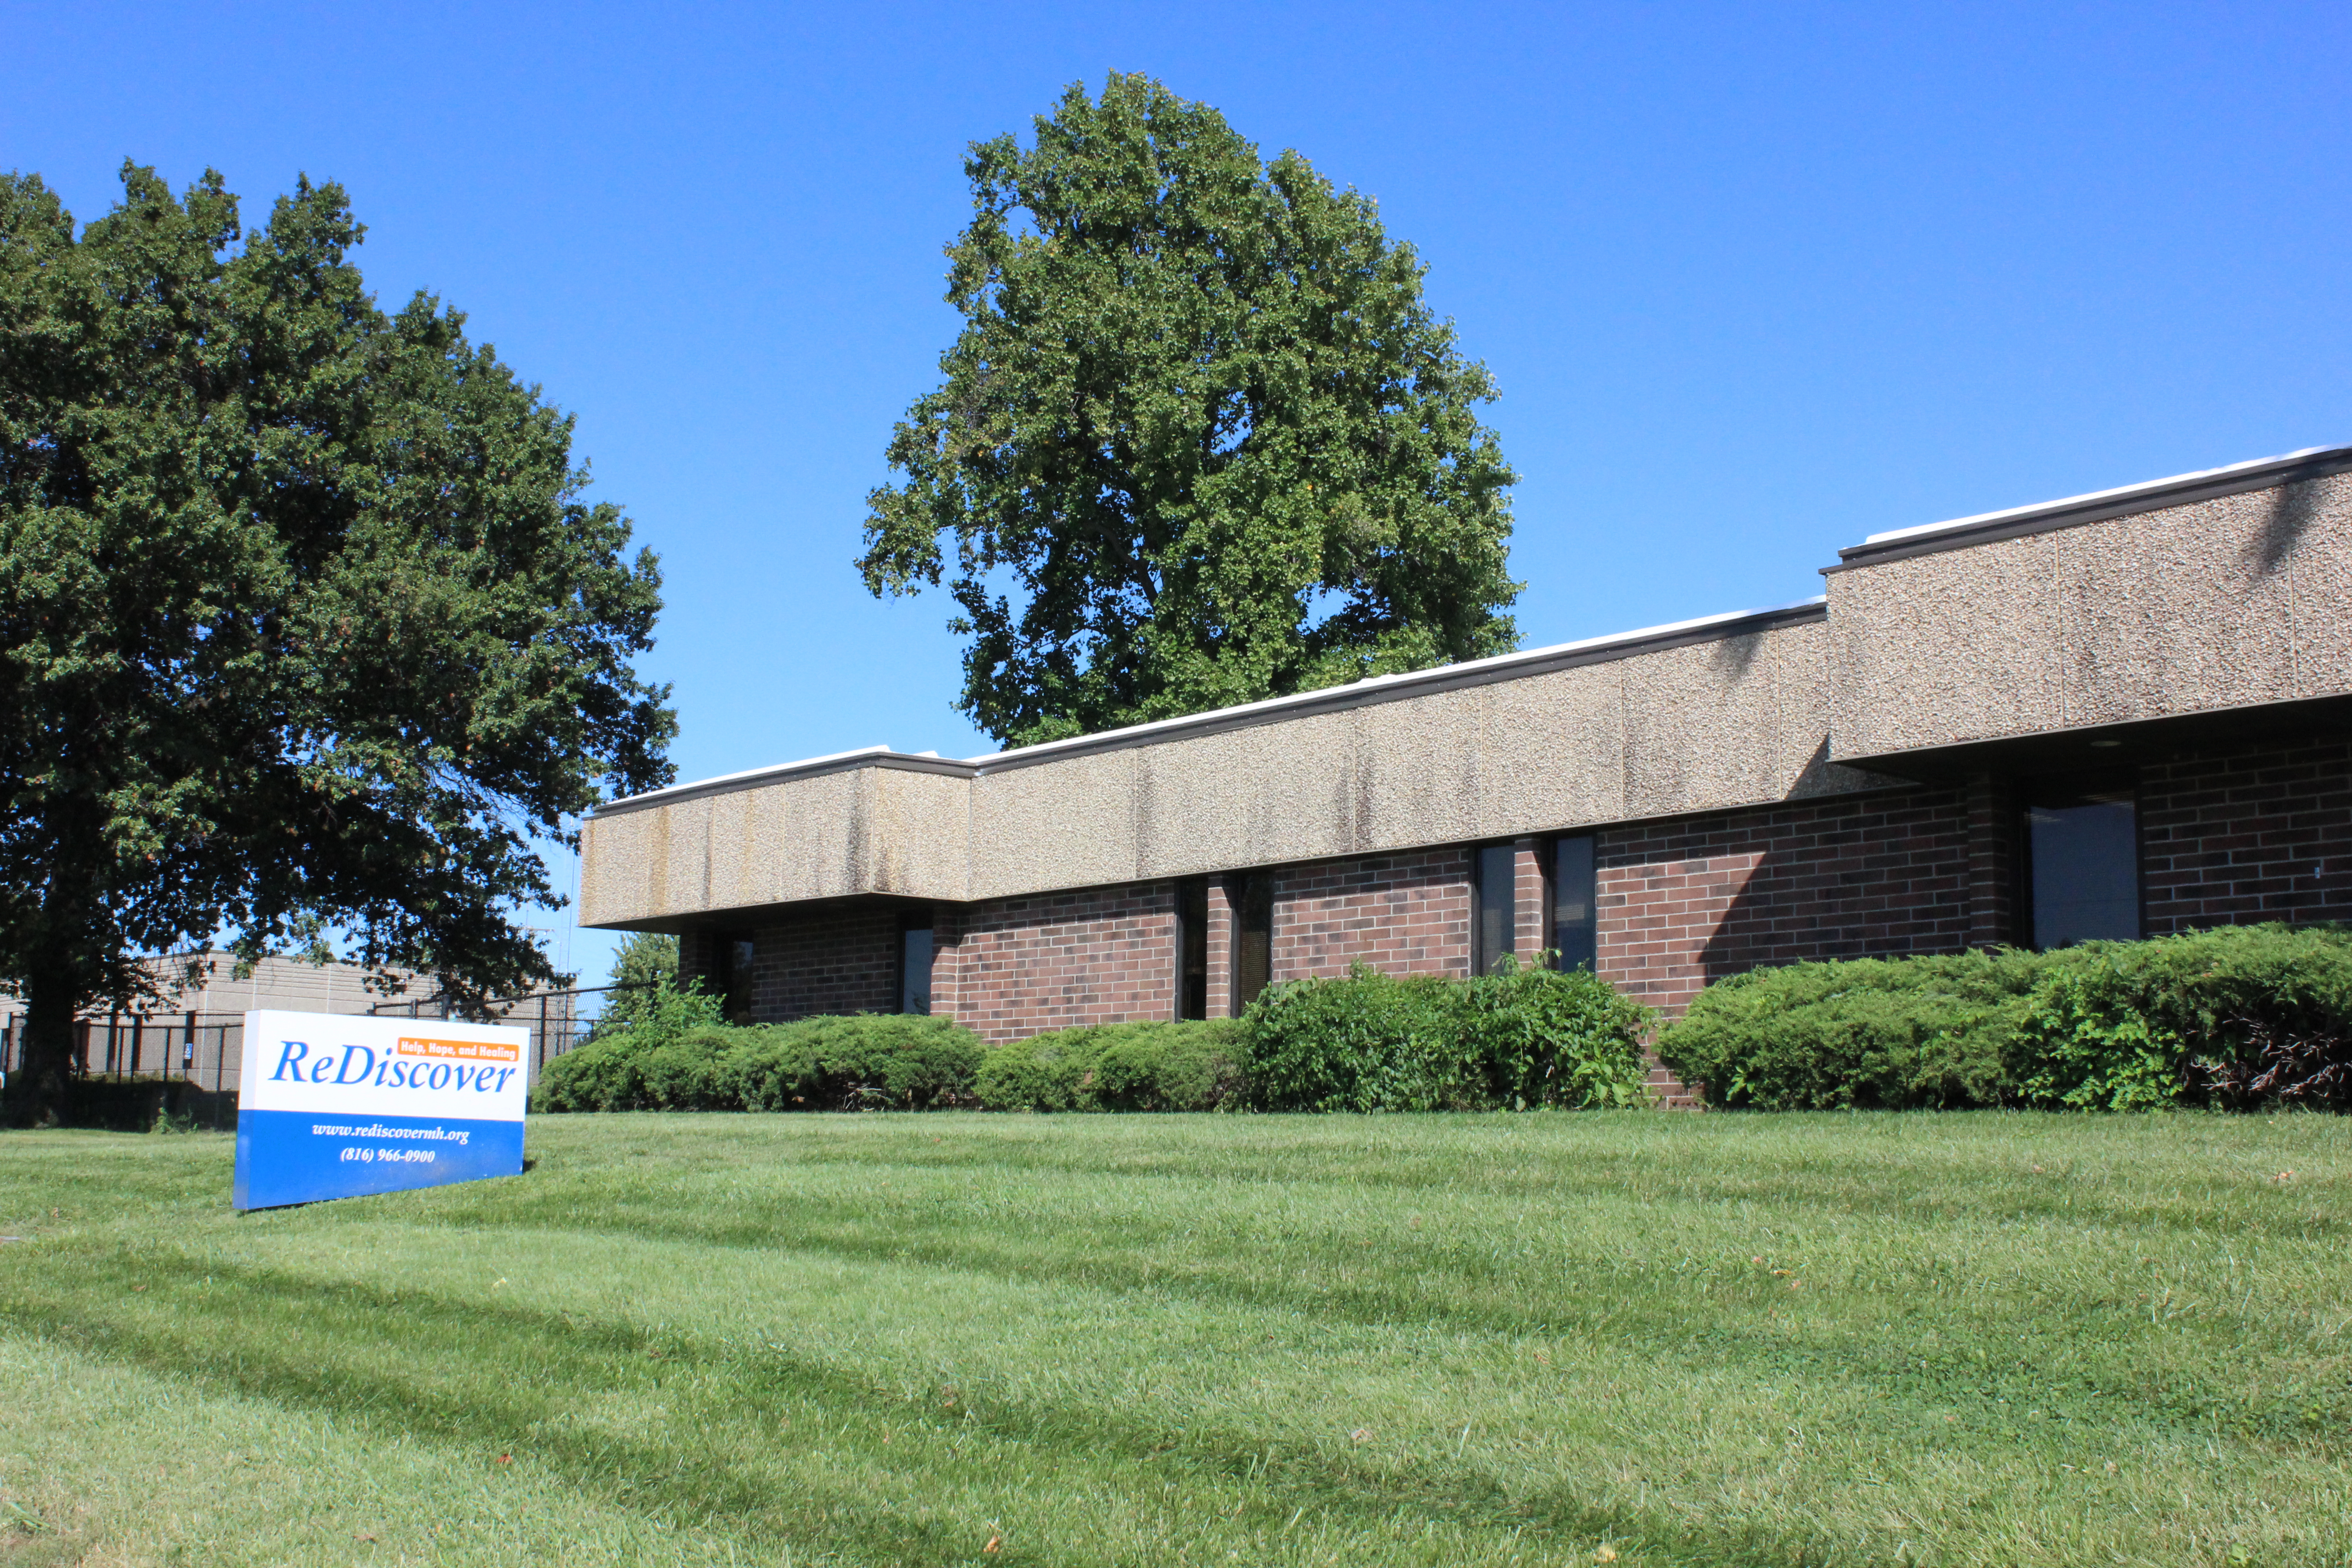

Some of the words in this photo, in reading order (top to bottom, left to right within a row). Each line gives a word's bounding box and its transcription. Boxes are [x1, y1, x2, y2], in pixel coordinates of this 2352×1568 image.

[401, 1041, 426, 1055] Help,
[429, 1043, 456, 1056] Hope,
[458, 1045, 476, 1056] and
[479, 1046, 515, 1060] Healing
[268, 1041, 516, 1093] ReDiscover
[312, 1123, 470, 1145] www.rediscovermh.org
[340, 1147, 374, 1163] (816)
[377, 1148, 436, 1162] 966-0900
